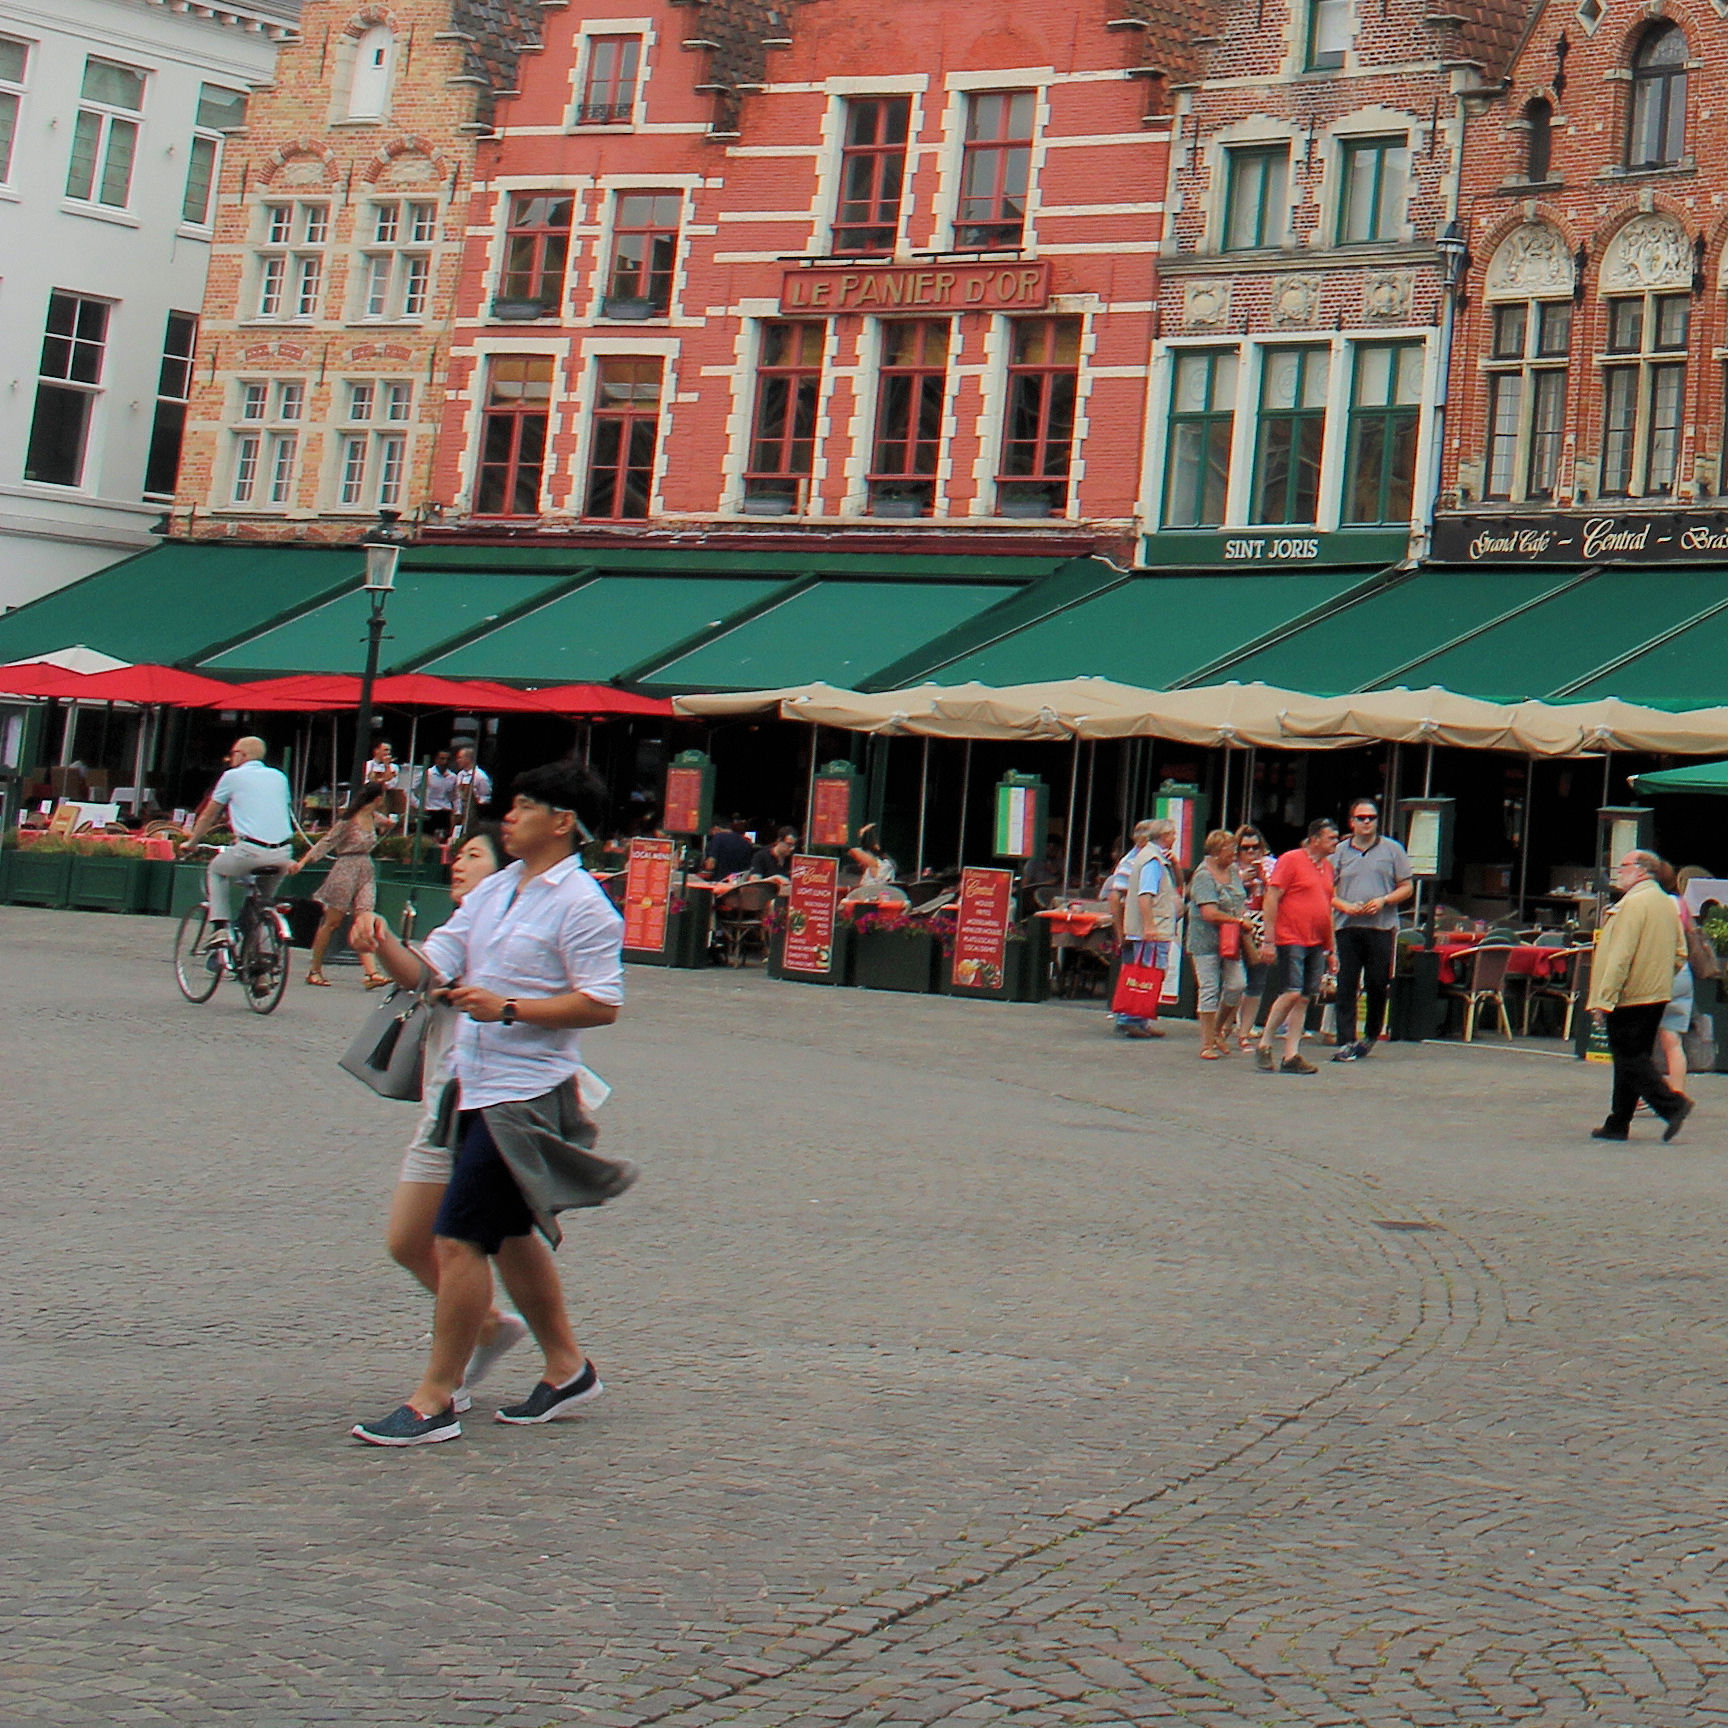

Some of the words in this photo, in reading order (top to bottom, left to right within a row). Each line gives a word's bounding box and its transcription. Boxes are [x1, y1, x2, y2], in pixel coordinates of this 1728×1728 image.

[791, 281, 830, 307] LE
[838, 272, 956, 308] PANIER
[965, 270, 1041, 303] D'OR
[1225, 539, 1266, 559] SINT
[1268, 538, 1320, 559] JORIS
[1469, 529, 1519, 561] Grand
[1583, 518, 1651, 559] Central
